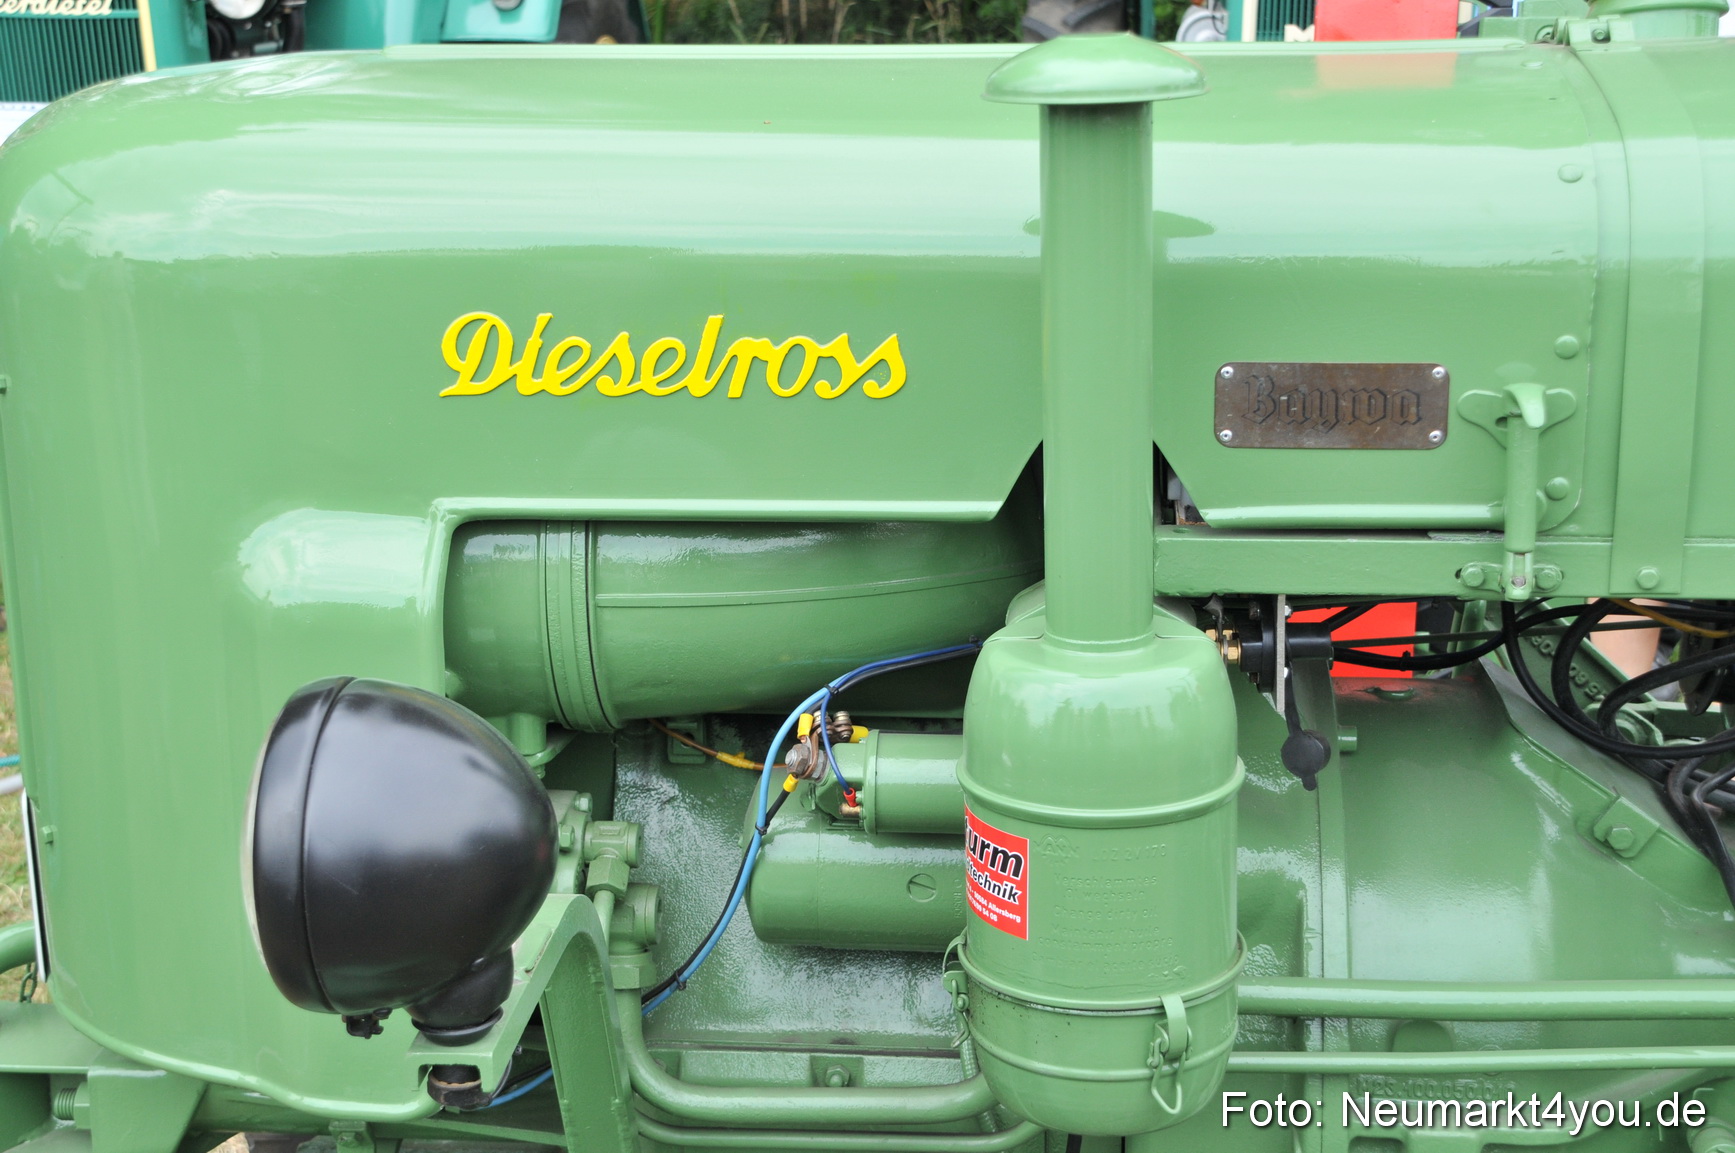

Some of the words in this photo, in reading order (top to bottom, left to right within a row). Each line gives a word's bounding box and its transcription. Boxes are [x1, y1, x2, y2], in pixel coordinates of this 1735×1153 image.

[0, 0, 113, 16] erdiesel
[439, 311, 907, 399] Dieselross
[1241, 374, 1424, 435] Baywa
[966, 857, 1022, 905] technik
[988, 902, 1022, 923] Allersberg
[1053, 904, 1102, 922] Change
[1107, 907, 1138, 923] dirty
